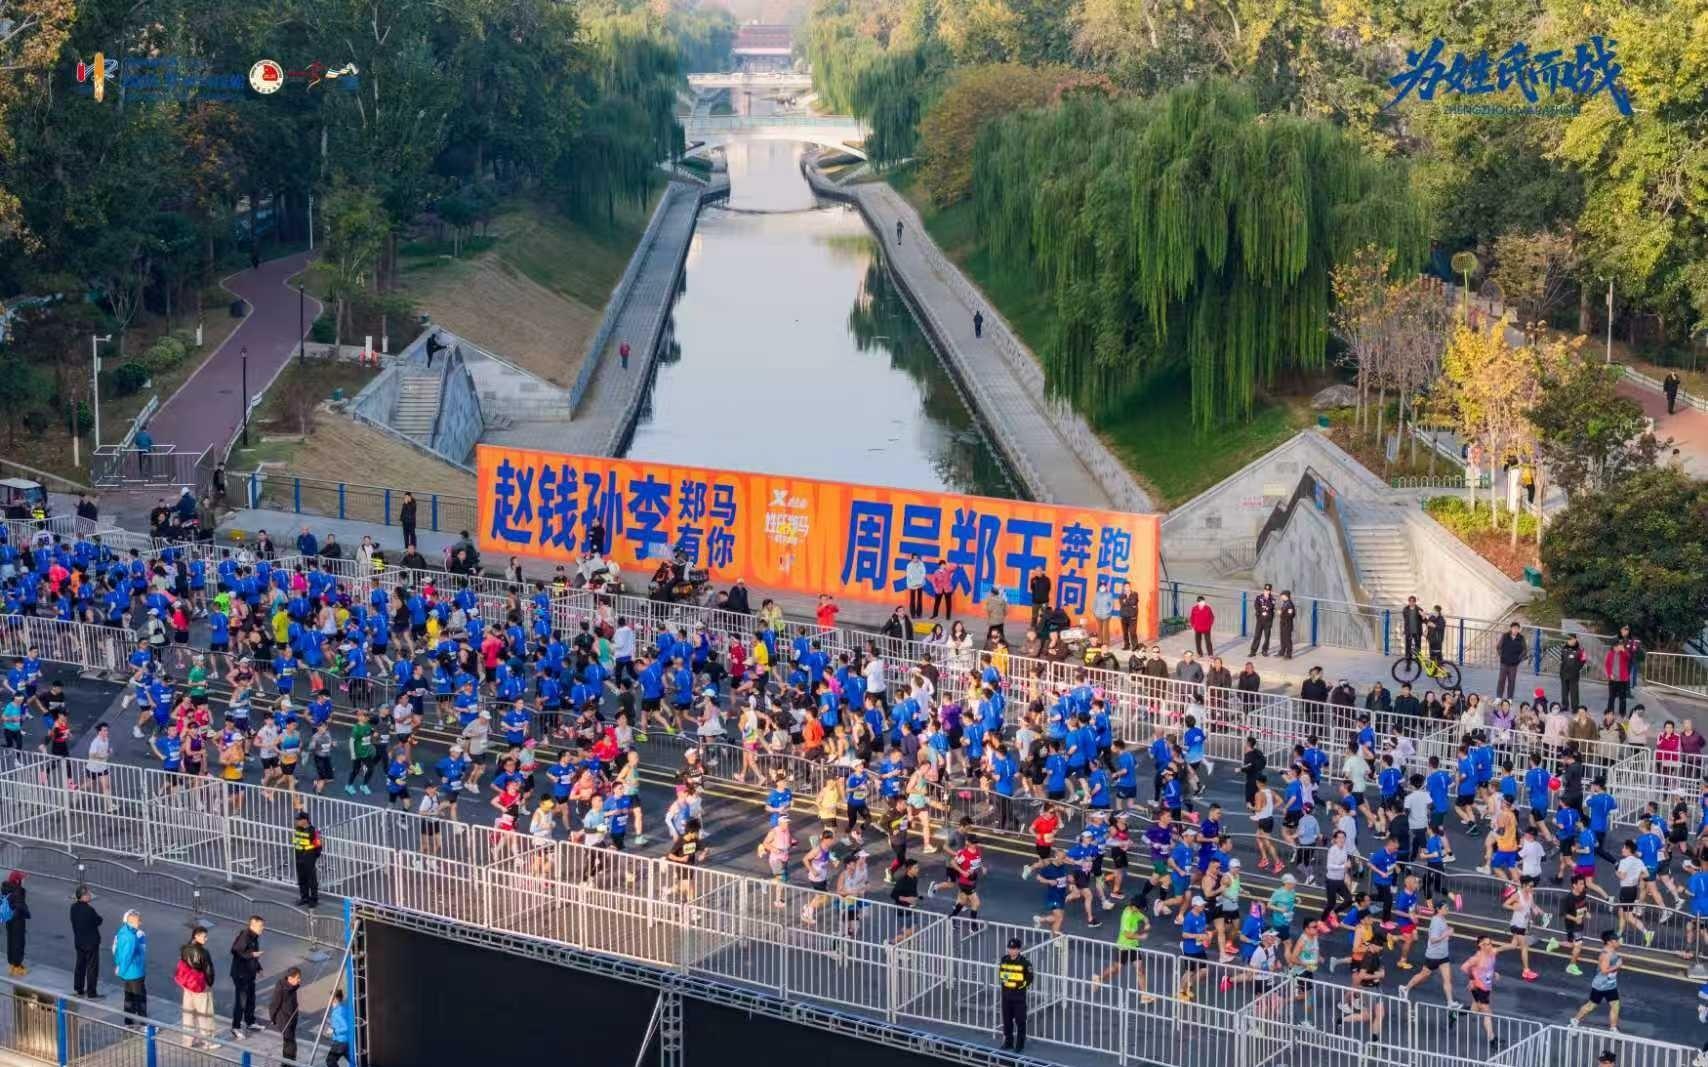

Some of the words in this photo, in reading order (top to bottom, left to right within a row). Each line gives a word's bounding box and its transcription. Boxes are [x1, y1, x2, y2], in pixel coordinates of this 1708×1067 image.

[491, 458, 671, 561] 赵钱孙李
[678, 479, 737, 527] 郑马
[674, 522, 736, 569] 有你
[841, 500, 1053, 605] 周吴郑王
[1060, 521, 1132, 574] 奔跑
